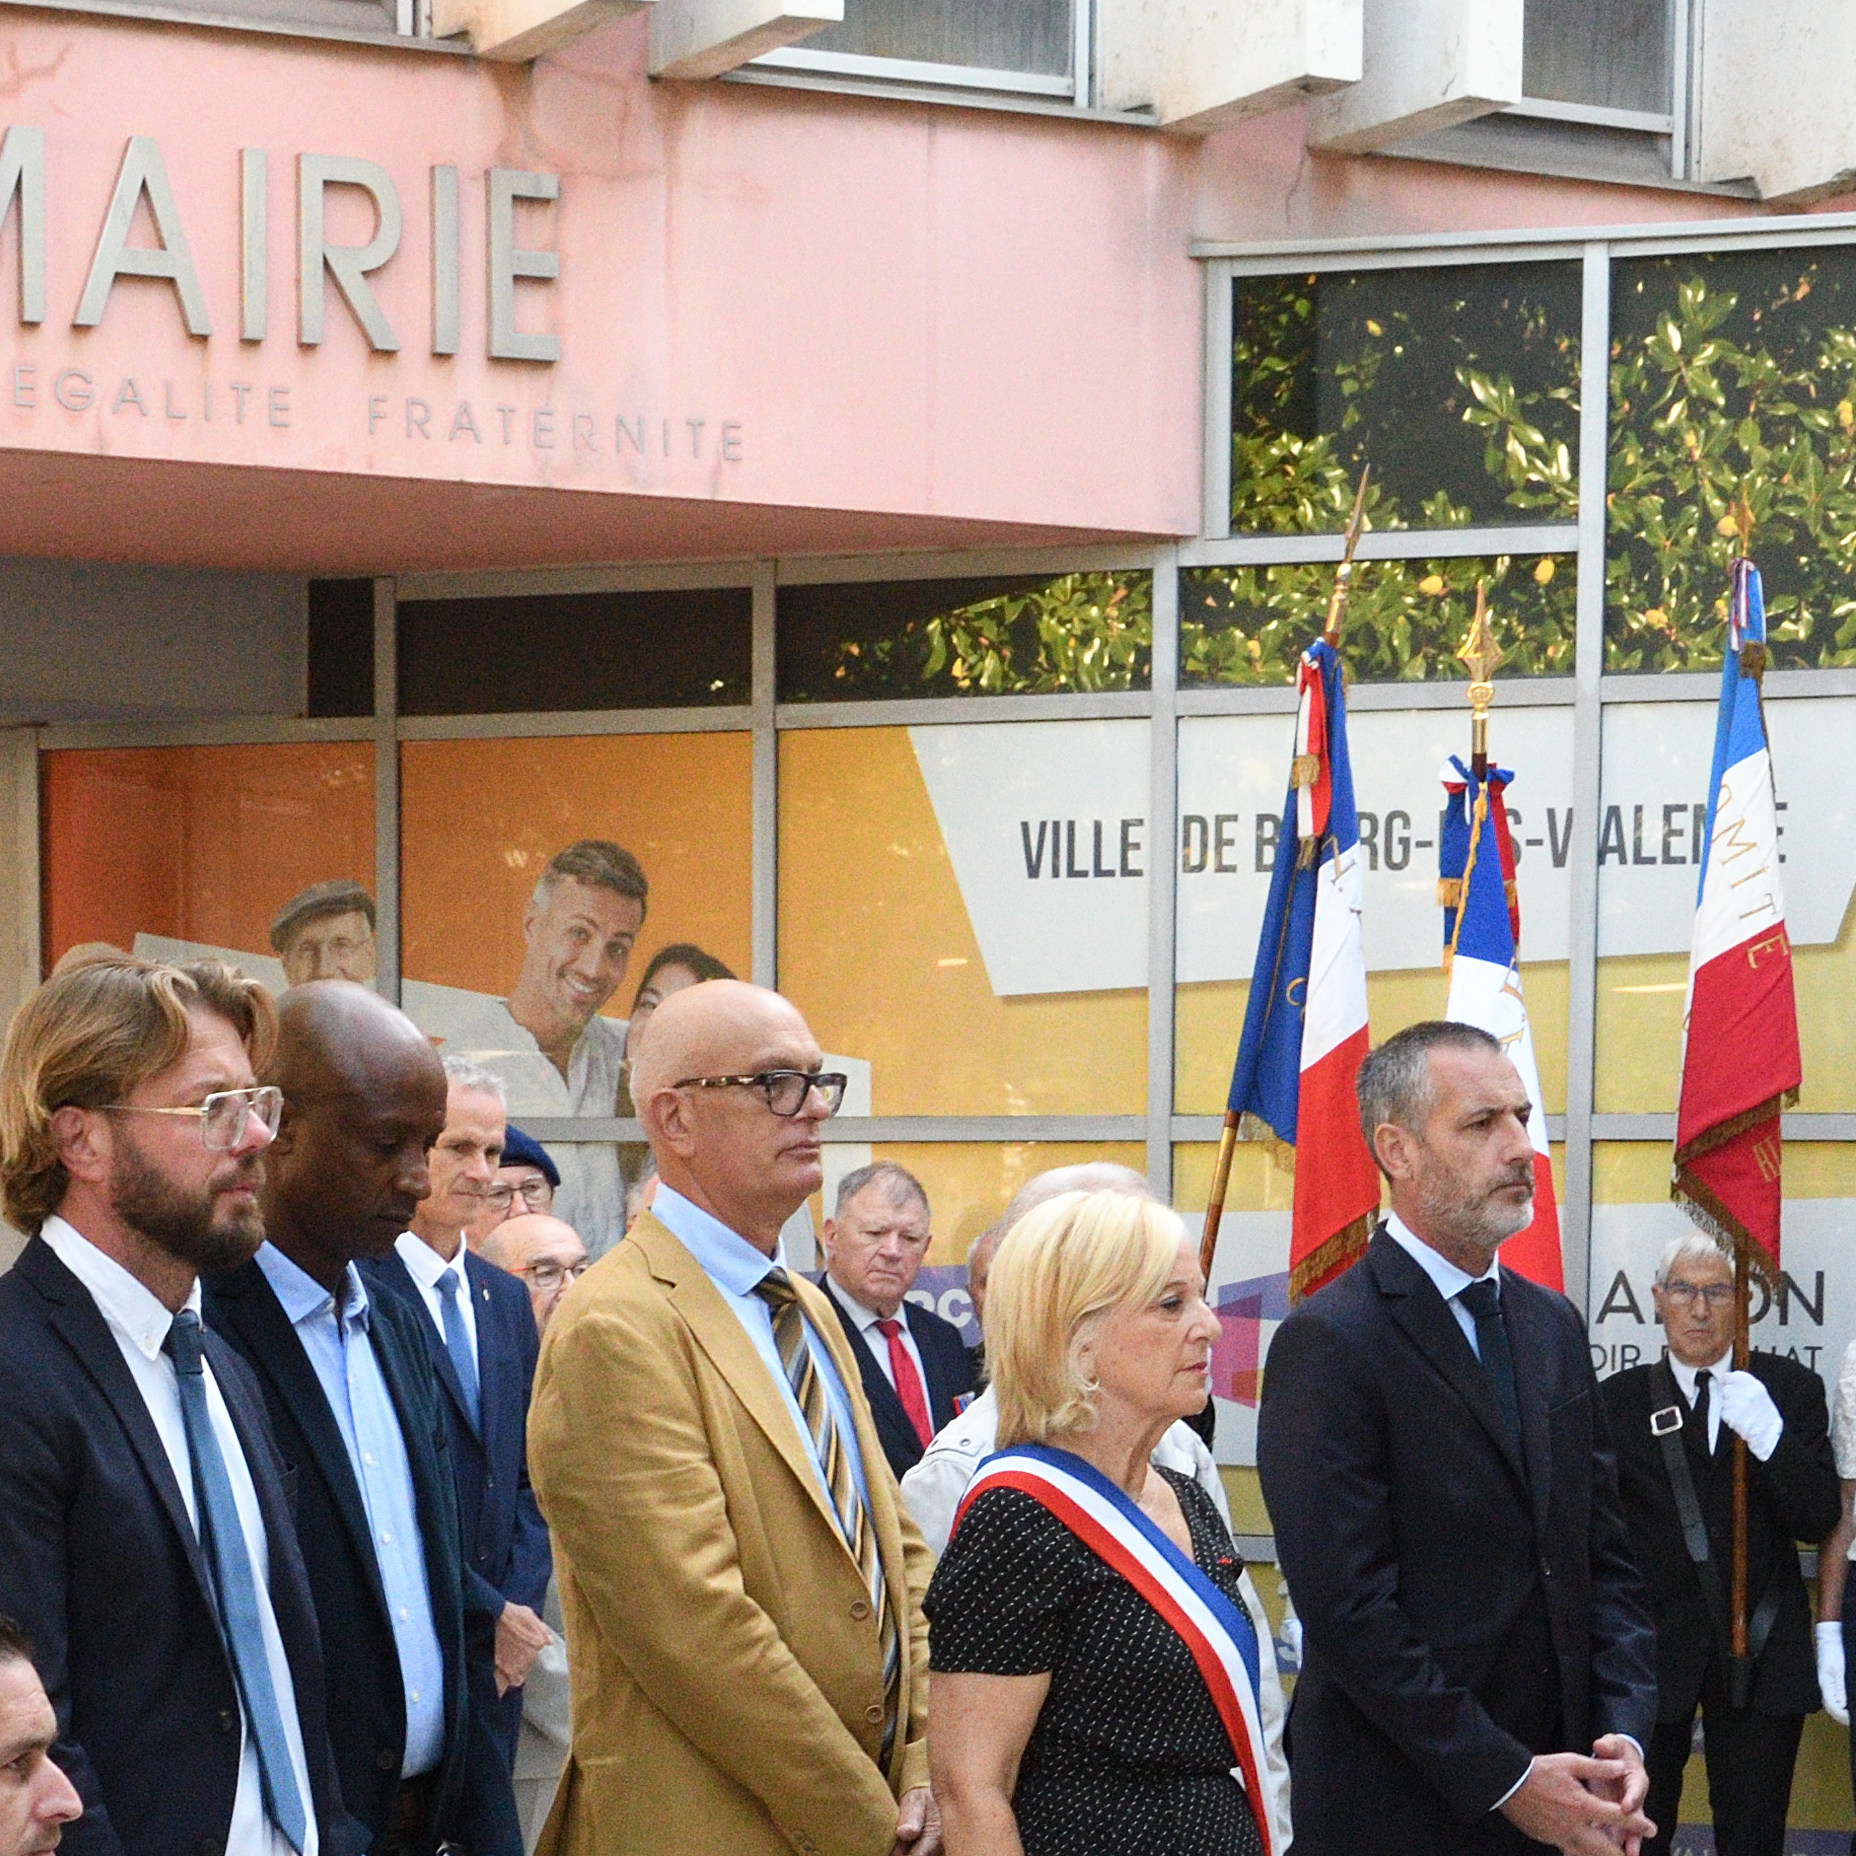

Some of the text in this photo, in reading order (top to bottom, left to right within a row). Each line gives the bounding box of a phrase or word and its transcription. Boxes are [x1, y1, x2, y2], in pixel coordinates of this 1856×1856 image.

[13, 364, 293, 428] EGALITE
[367, 394, 745, 464] FRATERNITE
[1020, 817, 1145, 880] VILLE
[1181, 813, 1240, 874] DE
